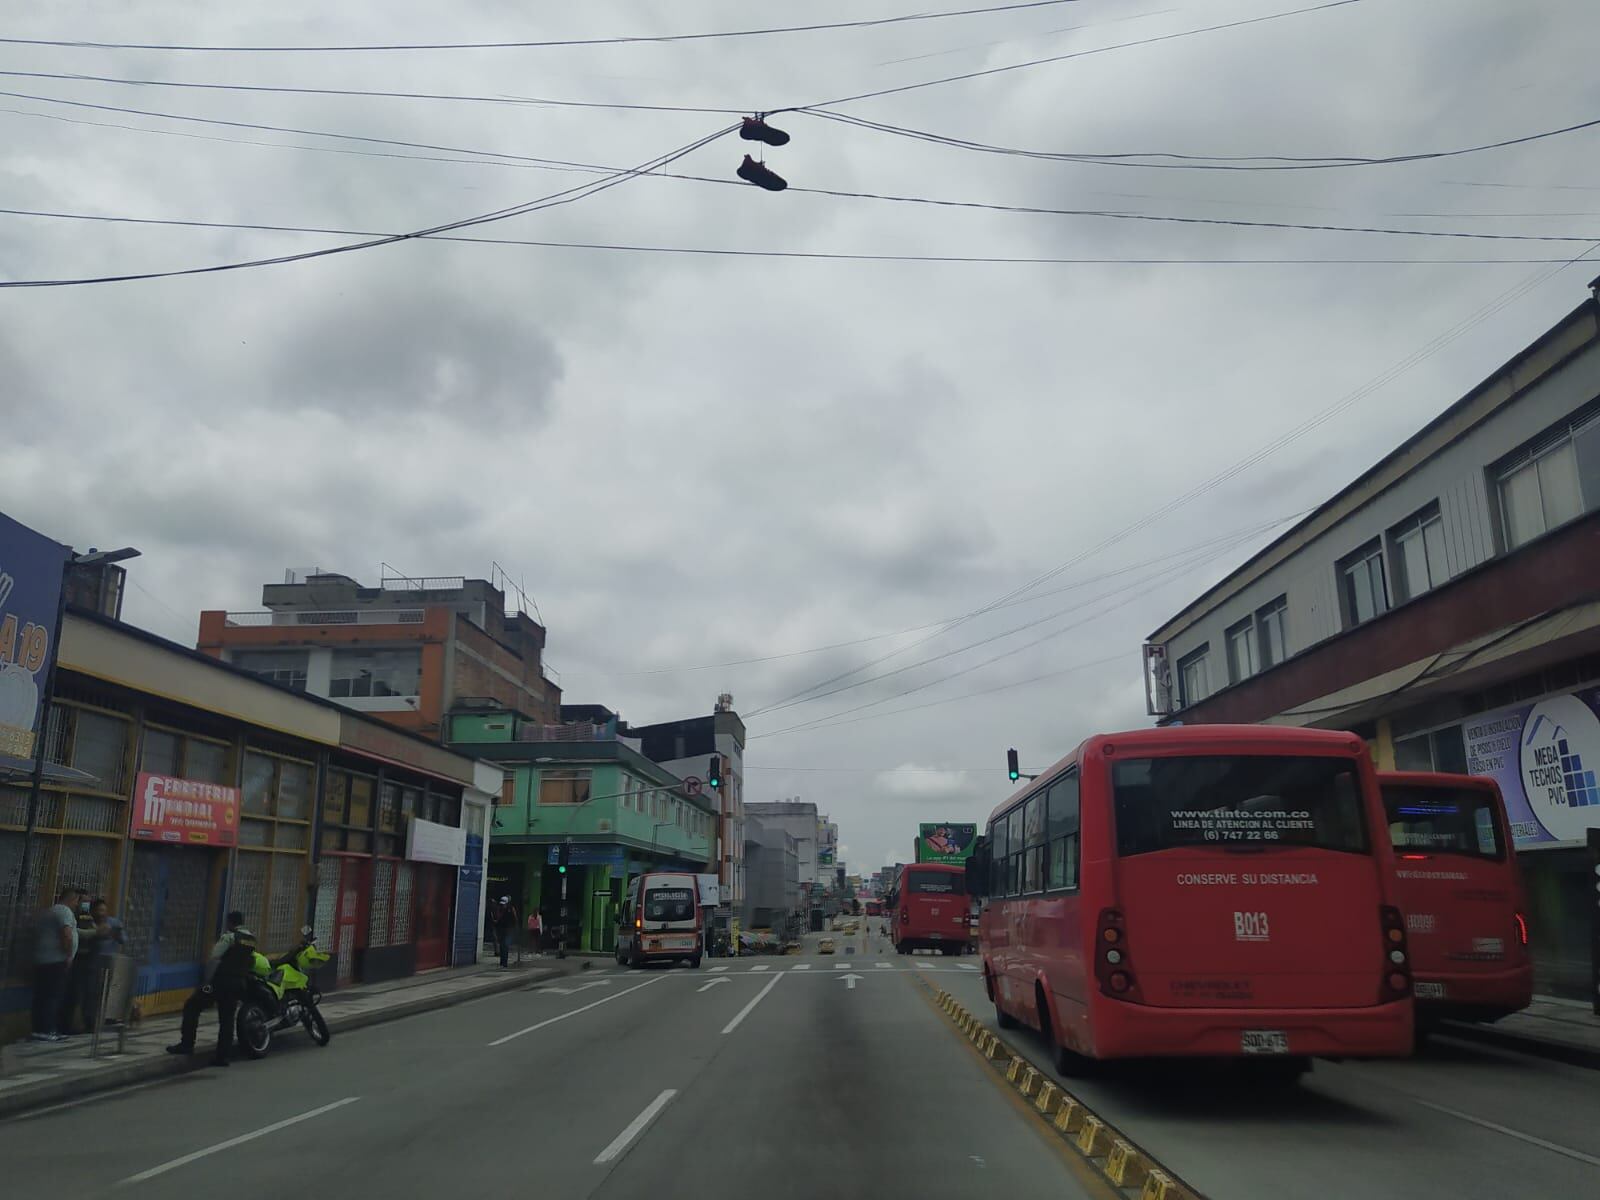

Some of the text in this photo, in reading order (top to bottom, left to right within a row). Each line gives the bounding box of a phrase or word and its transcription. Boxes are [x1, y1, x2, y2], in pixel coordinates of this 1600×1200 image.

[18, 621, 49, 675] 19
[1470, 744, 1477, 757] DE
[1534, 745, 1560, 768] MEGA
[1529, 766, 1563, 788] TECHOS
[1548, 786, 1566, 806] PVC
[1170, 808, 1310, 818] www.tinto.com.co
[1173, 820, 1314, 829] LINEA DE ATENCION AL CLIENTE
[1204, 830, 1279, 841] (6) 747 22 66
[1176, 873, 1318, 885] CONSERVE SU DISTANCIA
[1234, 911, 1270, 936] B013
